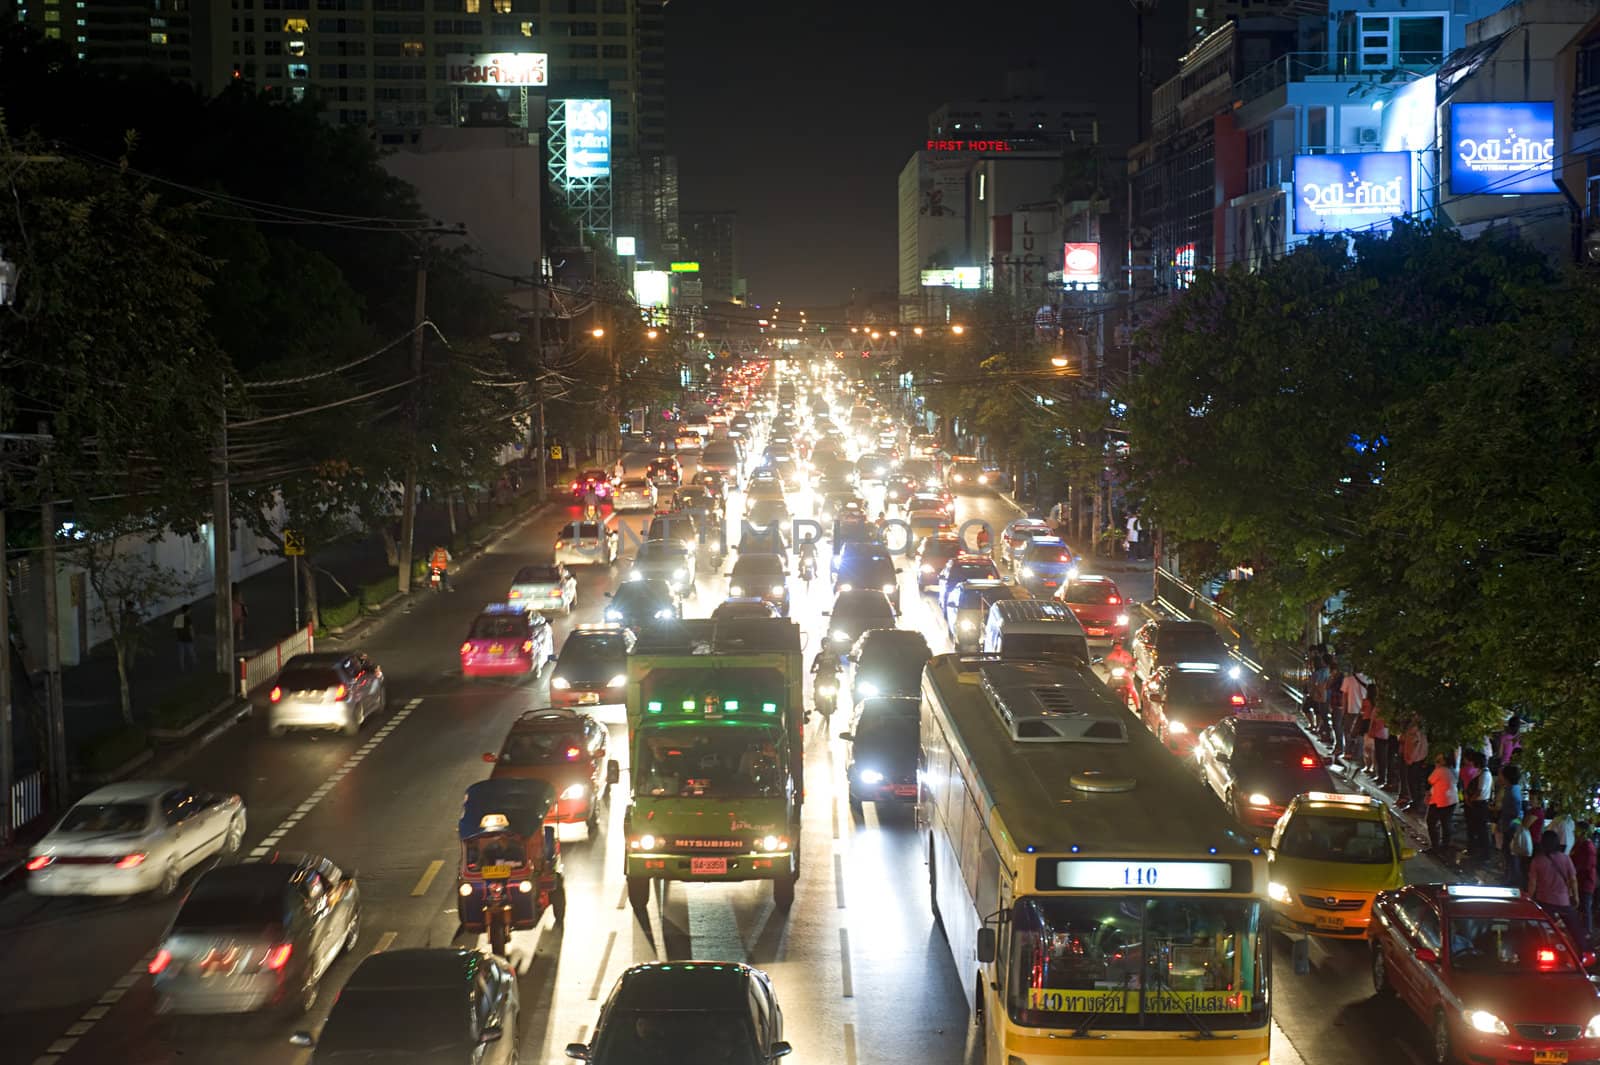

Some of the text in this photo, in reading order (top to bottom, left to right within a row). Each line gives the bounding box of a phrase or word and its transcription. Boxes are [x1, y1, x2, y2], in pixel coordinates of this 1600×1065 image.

[927, 140, 1012, 152] FIRST HOTEL
[675, 839, 743, 848] MITSUBISHI
[1124, 866, 1158, 885] 140
[1031, 991, 1063, 1010] 140
[1066, 993, 1126, 1011] ทางด่วน
